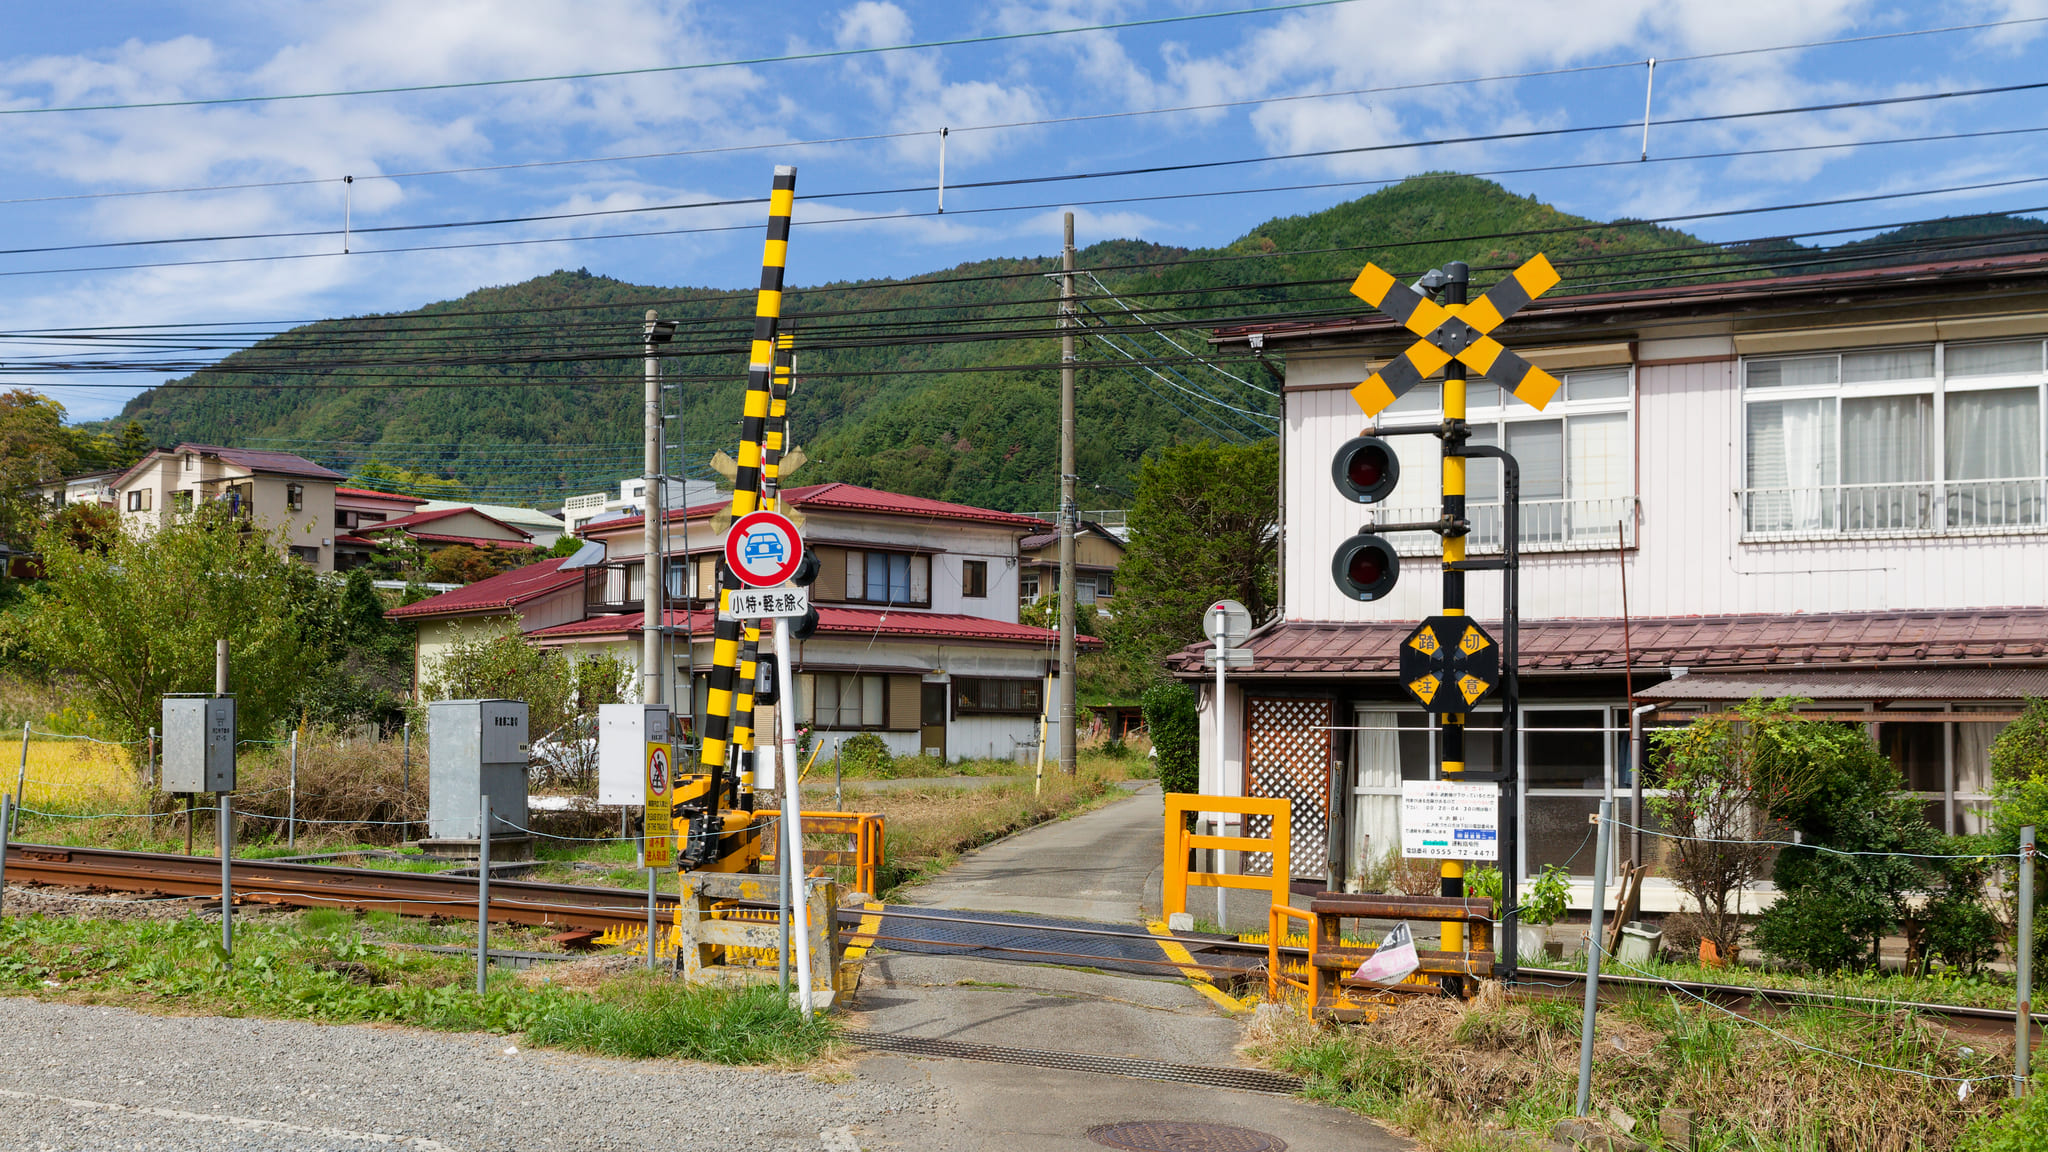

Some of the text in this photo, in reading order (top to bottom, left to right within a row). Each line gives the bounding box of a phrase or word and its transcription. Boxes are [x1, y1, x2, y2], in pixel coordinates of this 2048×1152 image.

[732, 593, 805, 614] 小特・軽を除く
[1418, 633, 1480, 650] 踏切
[1417, 678, 1480, 695] 注意
[1430, 848, 1495, 856] 0555-72-4471
